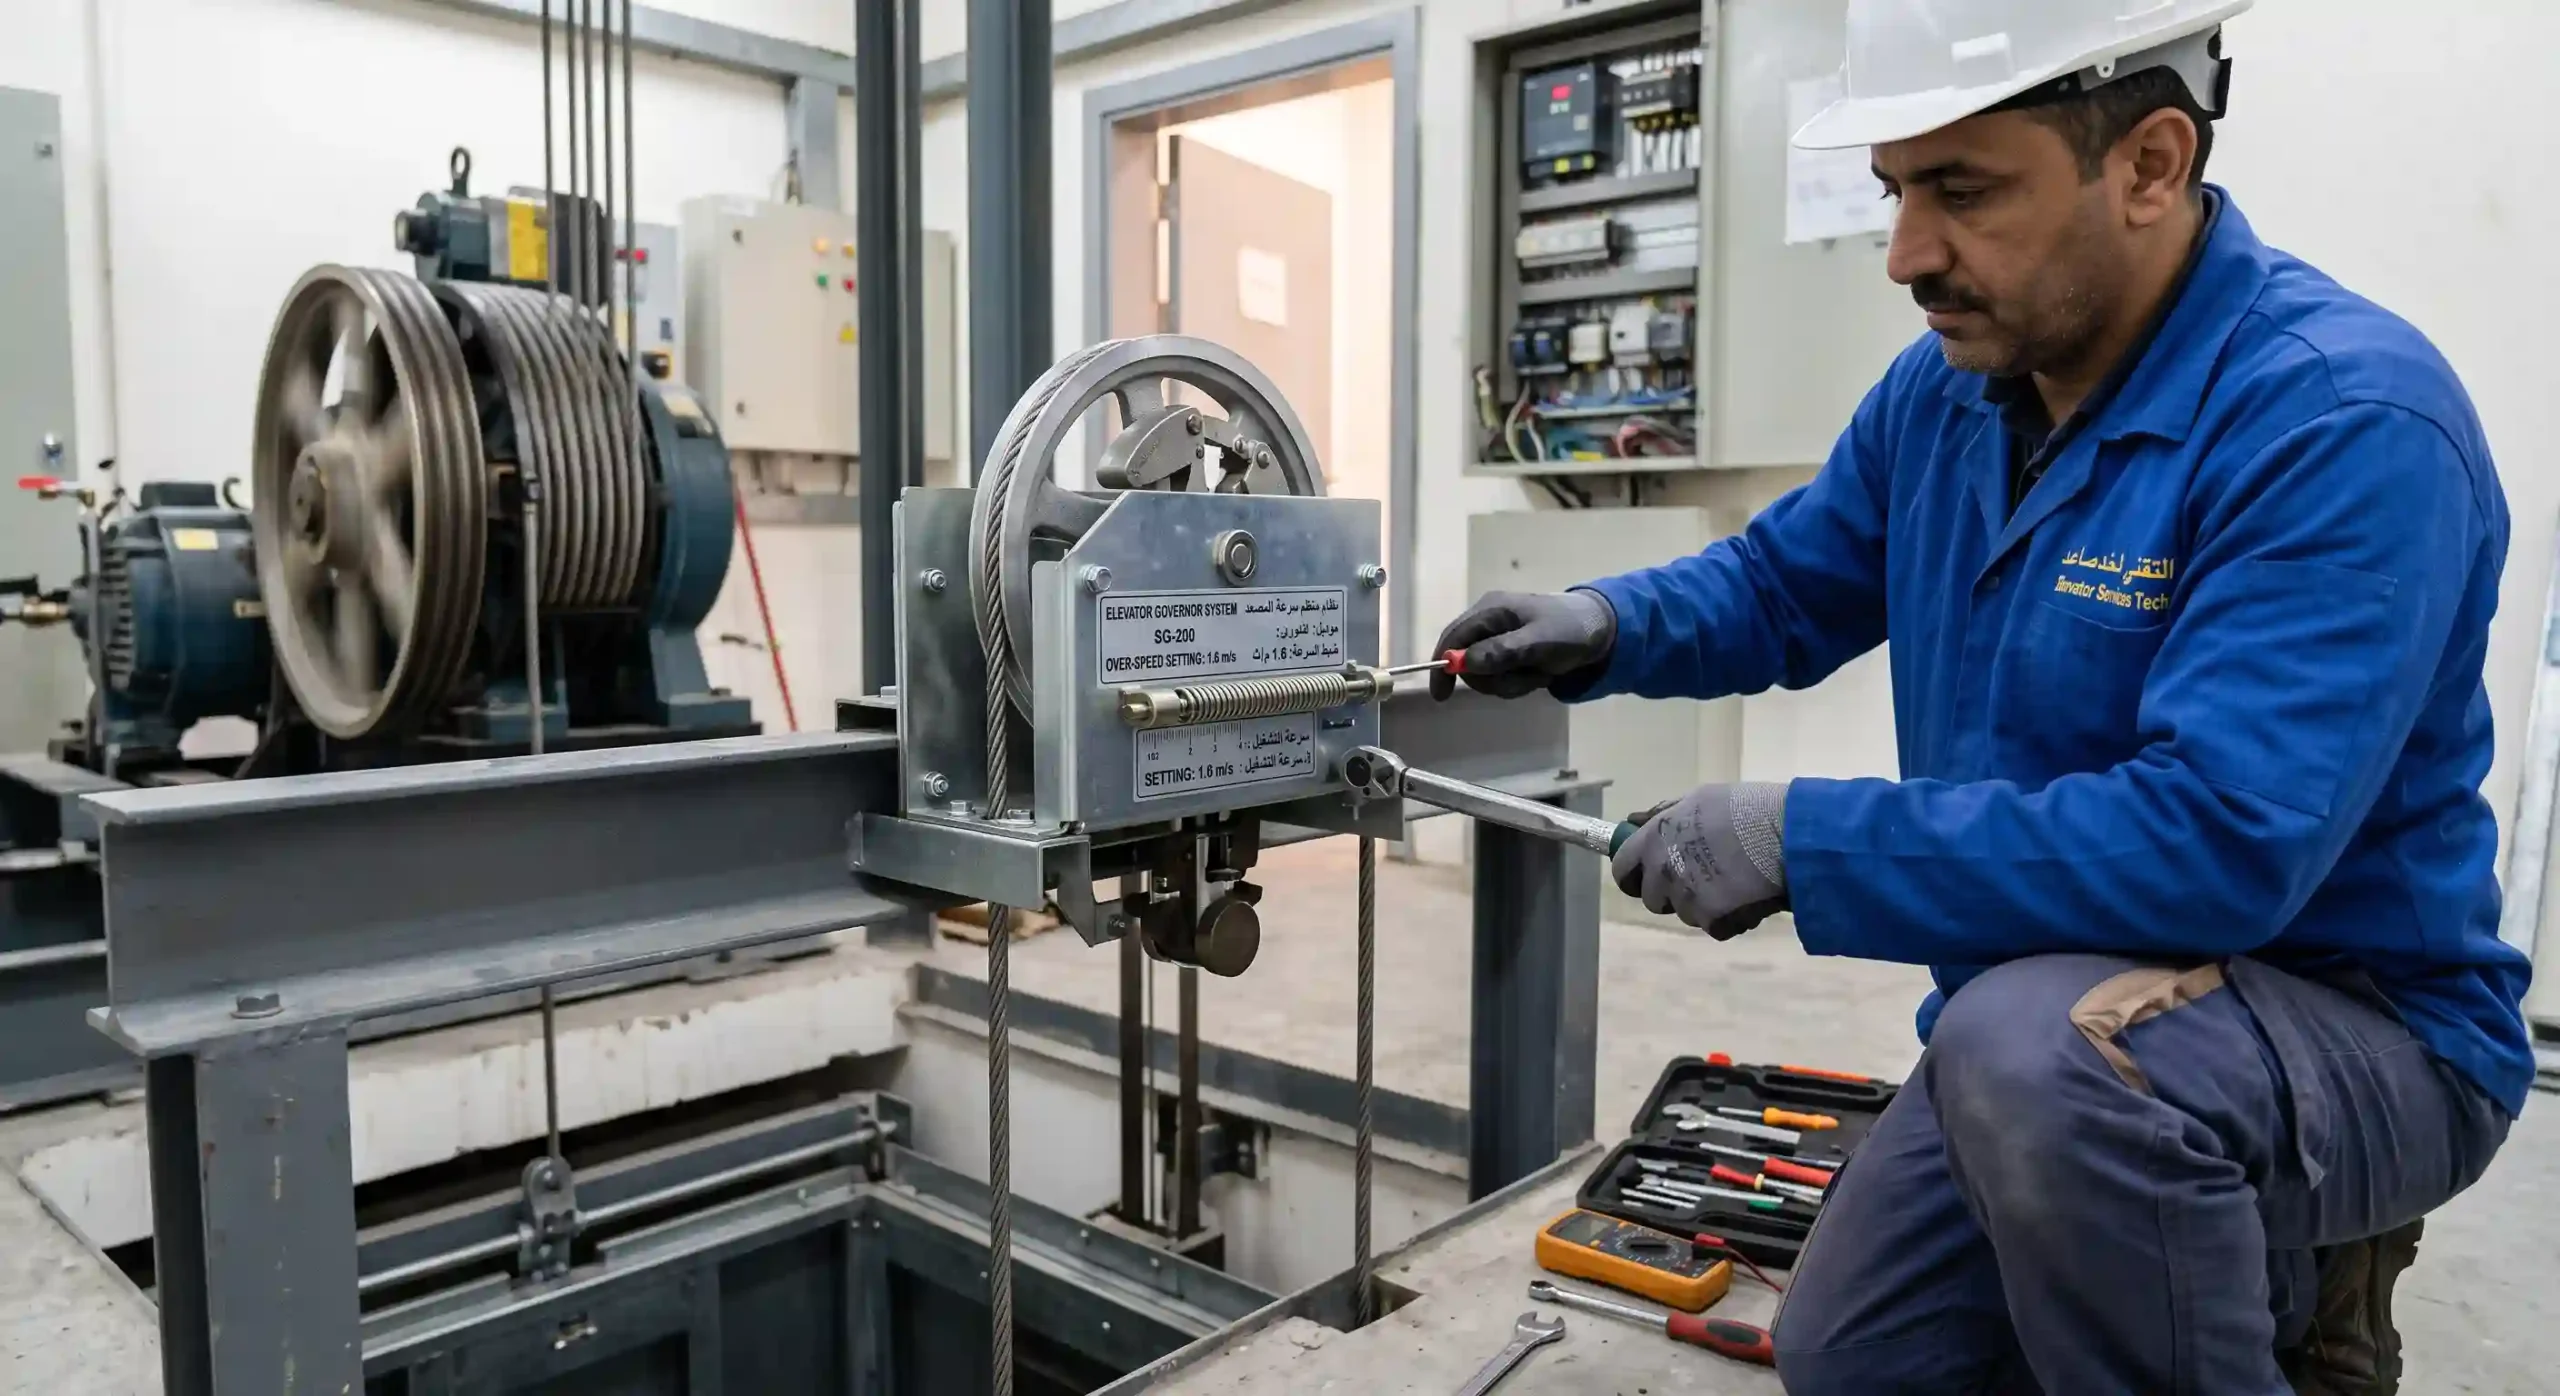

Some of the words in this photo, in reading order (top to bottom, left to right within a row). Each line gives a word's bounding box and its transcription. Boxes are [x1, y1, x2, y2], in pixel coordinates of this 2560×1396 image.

[1106, 605, 1153, 620] ELEVATOR
[1154, 603, 1203, 619] GOVERNOR
[1204, 602, 1238, 616] SYSTEM
[1154, 627, 1196, 644] SG-200
[1106, 654, 1164, 672] OVER-SPEED
[1165, 651, 1206, 668] SETTING:
[1207, 650, 1220, 664] 1.6
[1221, 650, 1237, 663] m/s
[1272, 646, 1287, 661] 1.6
[1188, 747, 1193, 755] 2
[1144, 767, 1195, 787] SETTING:
[1198, 763, 1214, 780] 1.6
[1215, 760, 1234, 777] m/s
